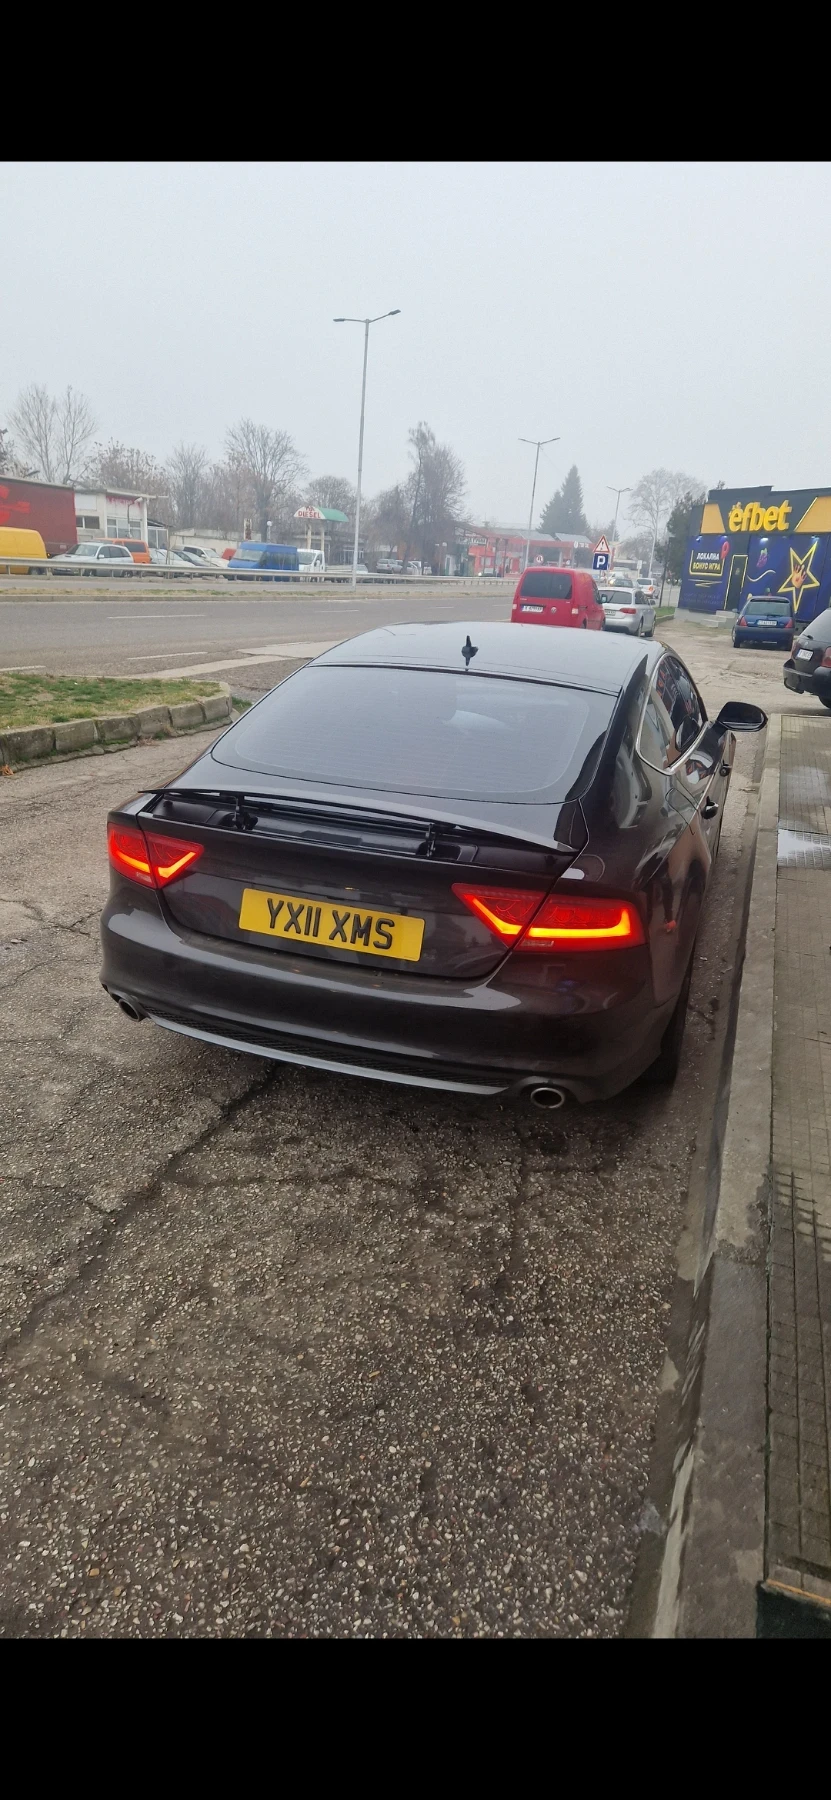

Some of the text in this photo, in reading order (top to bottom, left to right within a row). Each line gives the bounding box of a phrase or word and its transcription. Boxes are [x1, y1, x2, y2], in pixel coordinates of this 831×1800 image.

[728, 499, 793, 532] efbet
[596, 555, 606, 569] P
[696, 552, 720, 561] ЛОКАЛНА
[692, 561, 721, 571] БОНУС ИГРА
[267, 898, 395, 950] YX11 XMS
